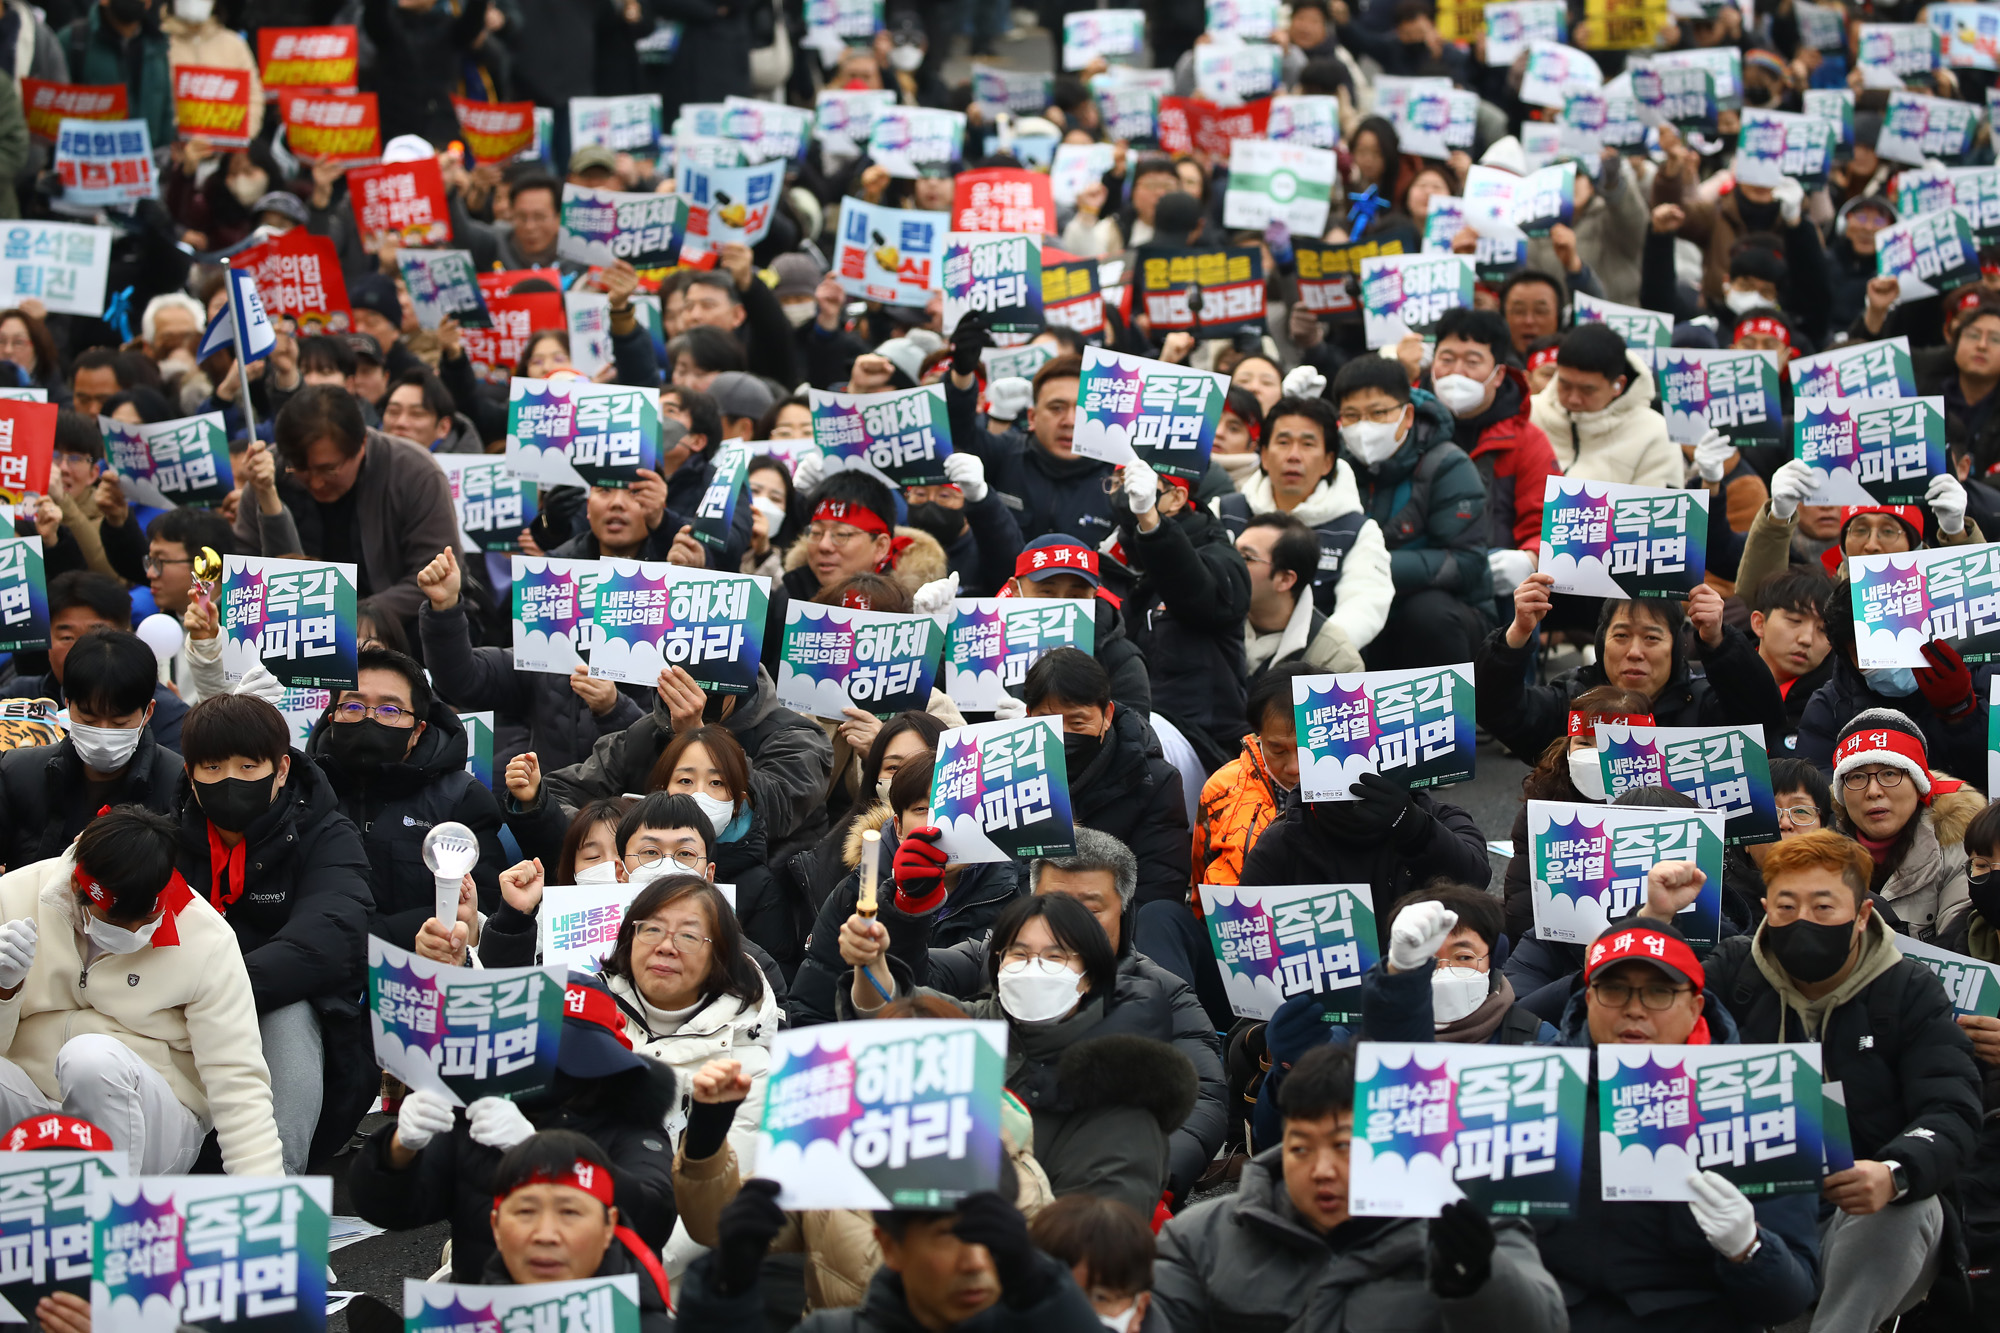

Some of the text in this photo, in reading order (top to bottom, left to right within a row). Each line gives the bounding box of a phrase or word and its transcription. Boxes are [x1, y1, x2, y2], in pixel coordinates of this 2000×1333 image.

[971, 183, 1033, 207] 윤석열
[617, 197, 676, 230] 해체
[5, 228, 95, 266] 윤석열
[613, 227, 673, 258] 하라
[972, 239, 1028, 272] 해체
[15, 266, 77, 300] 퇴진
[969, 273, 1028, 312] 하라
[1403, 258, 1461, 293] 해체
[1402, 292, 1461, 326] 하라
[1607, 316, 1660, 346] 즉각
[1087, 377, 1140, 393] 내란수괴
[1666, 370, 1705, 388] 내란수괴
[1707, 357, 1764, 393] 즉각
[1840, 345, 1896, 390] 즉각
[518, 403, 572, 420] 내란수괴
[1084, 392, 1136, 414] 윤석열
[1142, 375, 1212, 413] 즉각
[1667, 384, 1705, 404] 윤석열
[1709, 390, 1767, 428] 파면
[517, 417, 571, 439] 윤석열
[577, 393, 643, 432] 즉각
[815, 417, 862, 432] 내란동조
[864, 392, 932, 437] 해체
[1802, 419, 1853, 440] 내란수괴
[1859, 402, 1927, 447] 즉각
[149, 421, 210, 464] 즉각
[572, 430, 641, 467] 파면
[817, 429, 864, 446] 국민의힘
[871, 430, 936, 468] 하라
[1133, 414, 1204, 451] 파면
[1802, 435, 1853, 461] 윤석열
[155, 455, 218, 493] 파면
[1859, 442, 1927, 484] 파면
[464, 464, 521, 499] 즉각
[464, 494, 522, 532] 파면
[1552, 506, 1609, 523] 내란수괴
[1614, 496, 1691, 538] 즉각
[1551, 521, 1608, 545] 윤석열
[1032, 548, 1089, 569] 총파업
[1611, 535, 1686, 576] 파면
[1861, 575, 1922, 602] 내란수괴
[1928, 549, 2000, 599] 즉각
[226, 584, 263, 606] 내란수괴
[267, 569, 338, 616] 즉각
[521, 584, 574, 602] 내란수괴
[601, 589, 667, 608] 내란동조
[671, 580, 751, 622] 해체
[1863, 591, 1922, 623] 윤석열
[227, 601, 262, 629] 윤석열
[521, 598, 573, 623] 윤석열
[601, 606, 665, 627] 국민의힘
[1005, 605, 1078, 647] 즉각
[1931, 594, 2000, 640] 파면
[262, 616, 337, 660] 파면
[666, 624, 744, 666] 하라
[788, 632, 852, 650] 내란동조
[856, 620, 931, 663] 해체
[953, 620, 1002, 645] 내란수괴
[788, 648, 850, 666] 국민의힘
[953, 636, 1001, 665] 윤석열
[1004, 648, 1041, 687] 파
[851, 659, 922, 702] 하라
[278, 693, 331, 712] 국민의힘
[1306, 697, 1369, 726] 내란수괴
[1376, 673, 1455, 726] 즉각
[1308, 716, 1370, 750] 윤석열
[1378, 714, 1456, 772] 파면
[936, 750, 979, 783] 내란수괴
[983, 726, 1046, 782] 즉각
[1608, 752, 1661, 776] 내란수괴
[1667, 732, 1745, 783] 즉각
[935, 773, 978, 808] 윤석열
[983, 773, 1052, 833] 파면
[1545, 836, 1606, 860] 내란수괴
[1613, 821, 1702, 868] 즉각
[1546, 855, 1605, 884] 윤석열
[552, 904, 621, 932] 내란동조
[1216, 914, 1269, 940] 내란수괴
[1274, 893, 1354, 946] 즉각
[553, 922, 620, 950] 국민의힘
[1220, 934, 1272, 963] 윤석열
[1589, 932, 1665, 966] 총파업
[1281, 941, 1361, 996] 파면
[378, 977, 439, 1008] 내란수괴
[445, 973, 545, 1032] 즉각
[378, 999, 437, 1034] 윤석열
[440, 1022, 538, 1080] 파면
[770, 1056, 854, 1106] 내란동조
[856, 1033, 974, 1105] 해체
[1697, 1052, 1798, 1114] 즉각
[1367, 1079, 1452, 1110] 내란수괴
[1459, 1057, 1565, 1122] 즉각
[1612, 1077, 1690, 1108] 내란수괴
[9, 1117, 93, 1151] 총파업
[852, 1099, 972, 1170] 하라
[1366, 1103, 1448, 1143] 윤석열
[1613, 1101, 1690, 1136] 윤석열
[1454, 1116, 1558, 1182] 파면
[1698, 1106, 1797, 1168] 파면
[0, 1160, 94, 1227] 즉각
[103, 1216, 179, 1248] 내란수괴
[186, 1190, 304, 1258] 즉각
[0, 1221, 93, 1286] 파면
[104, 1239, 177, 1286] 윤석열
[184, 1251, 298, 1324] 파면
[502, 1288, 609, 1333] 해체
